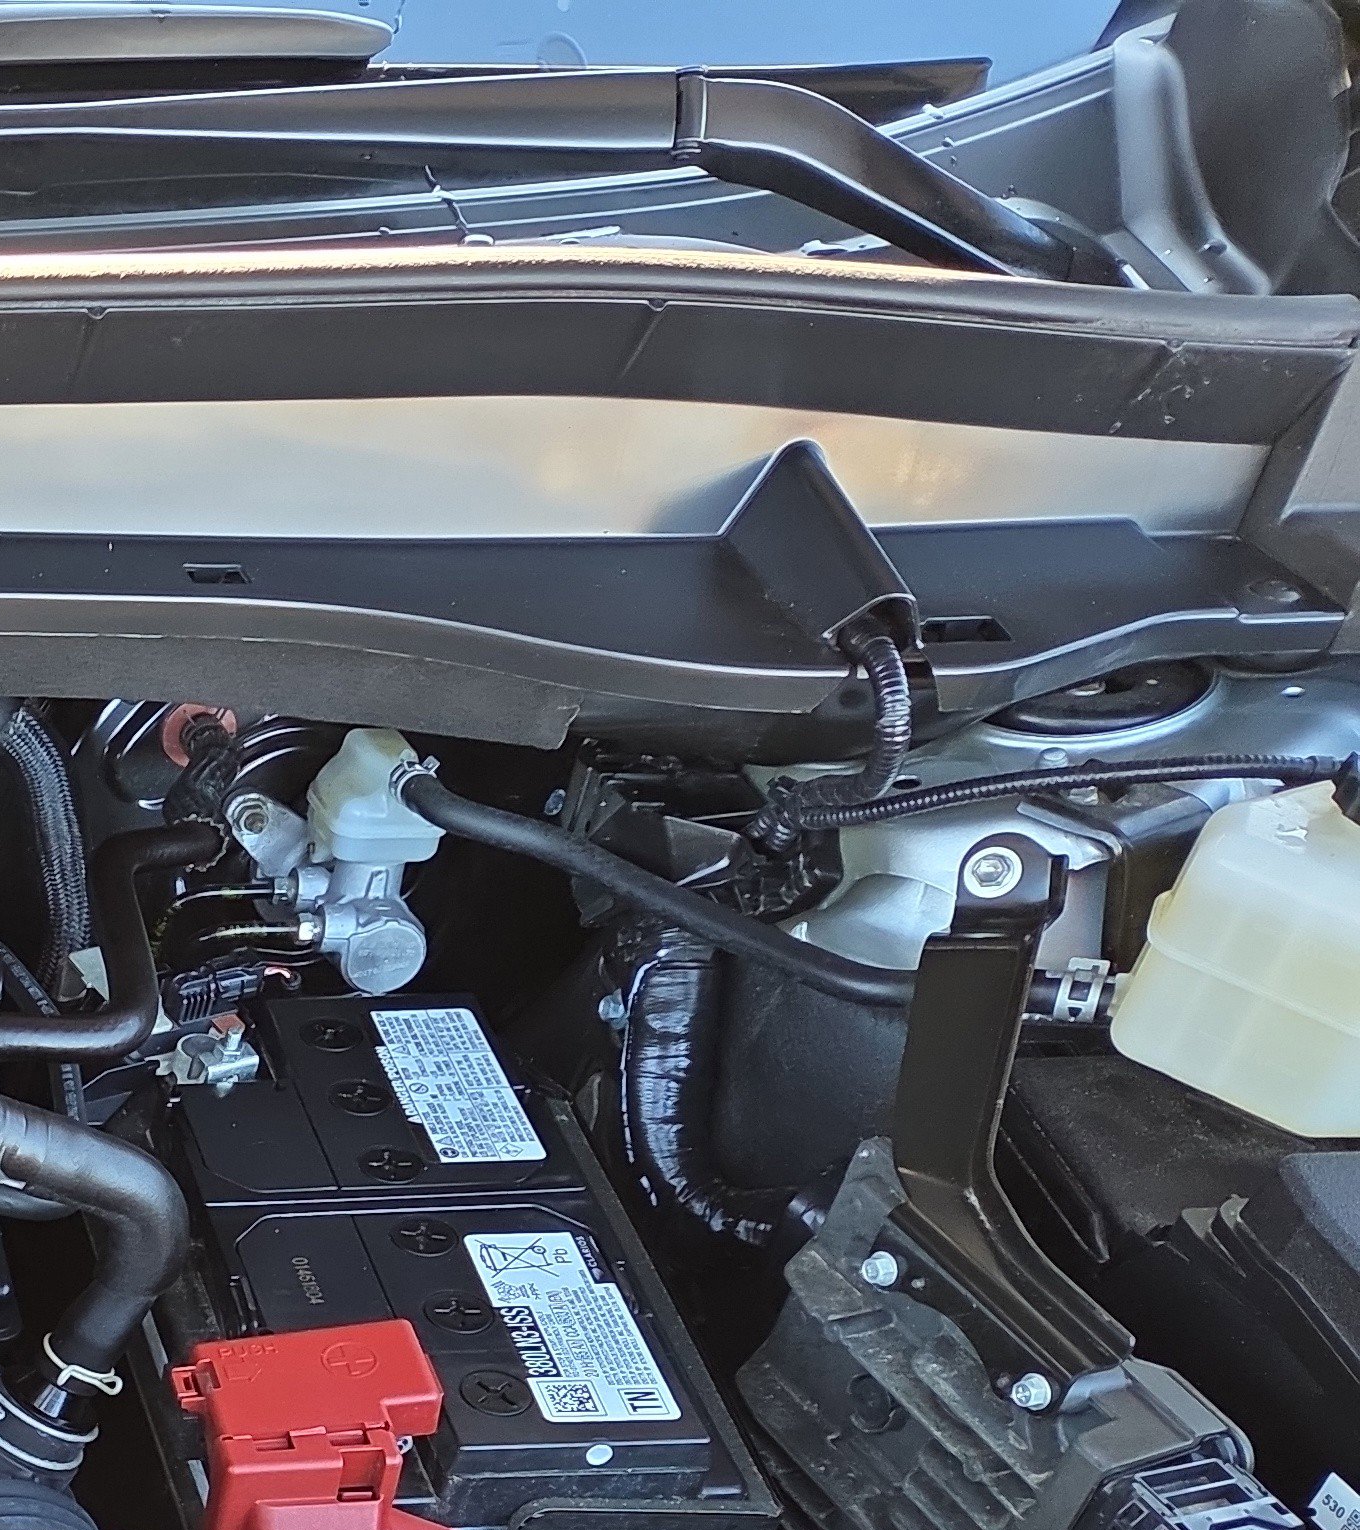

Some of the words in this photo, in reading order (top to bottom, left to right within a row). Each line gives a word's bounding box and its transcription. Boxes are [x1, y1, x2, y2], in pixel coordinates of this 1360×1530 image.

[549, 1247, 573, 1264] Pb
[219, 1344, 279, 1360] PUSH
[498, 1306, 559, 1376] 380LN3-ISS
[622, 1390, 665, 1412] TN
[1322, 1493, 1346, 1519] 530
